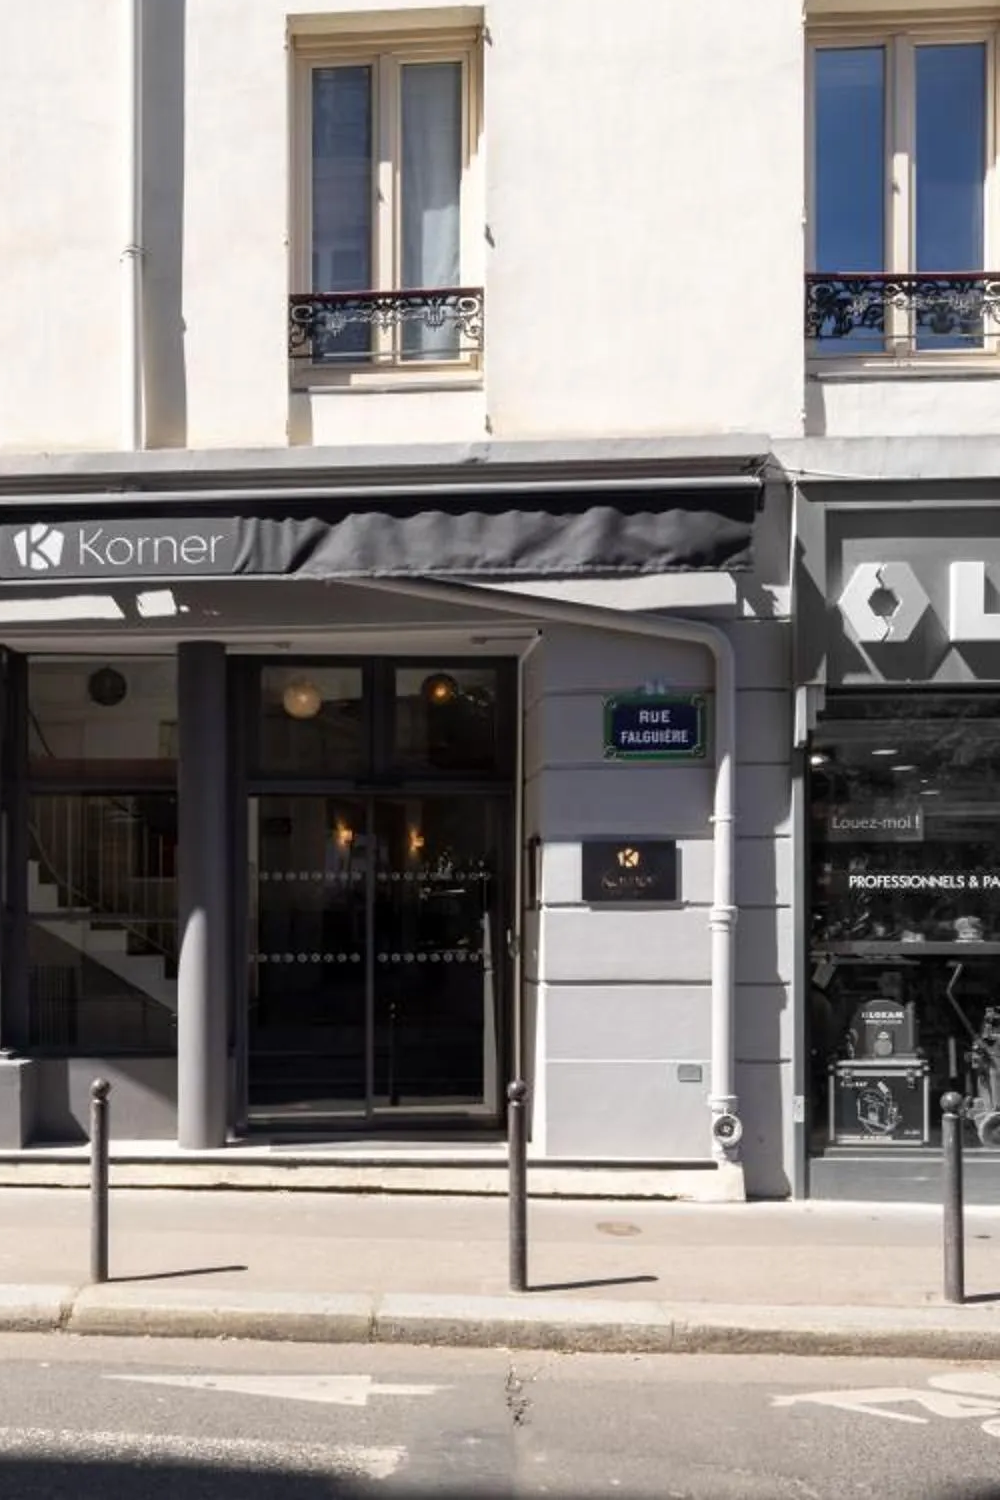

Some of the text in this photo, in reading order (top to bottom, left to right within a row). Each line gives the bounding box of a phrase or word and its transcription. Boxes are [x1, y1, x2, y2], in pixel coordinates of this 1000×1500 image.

[79, 528, 224, 565] Korner
[639, 709, 671, 724] RUE
[848, 874, 965, 889] PROFESSIONNELS
[968, 874, 979, 889] &
